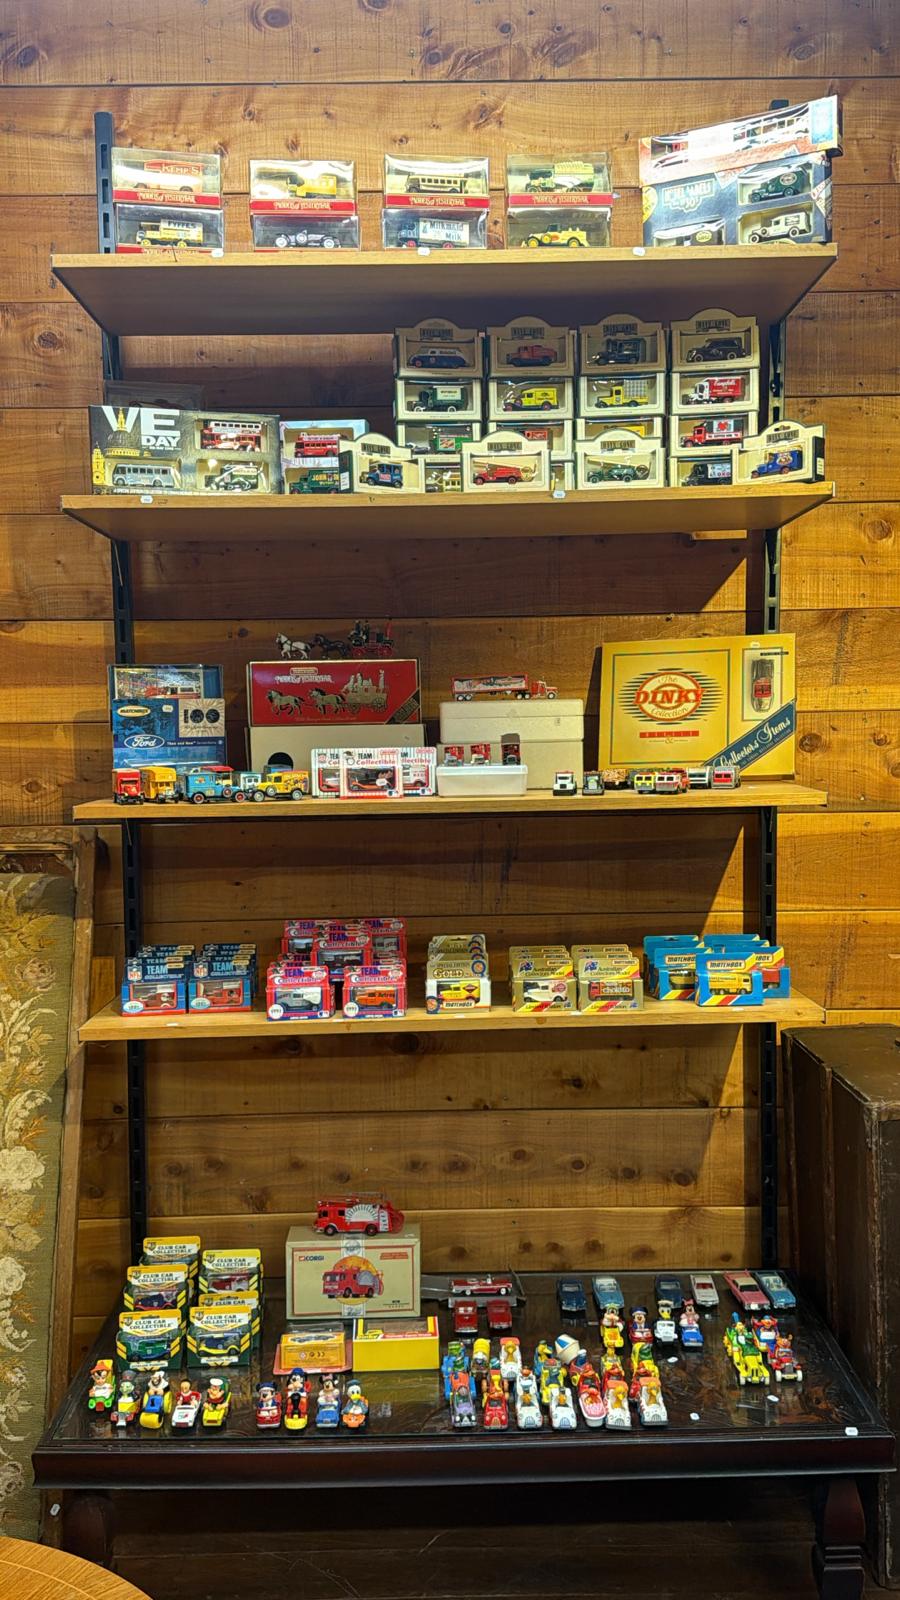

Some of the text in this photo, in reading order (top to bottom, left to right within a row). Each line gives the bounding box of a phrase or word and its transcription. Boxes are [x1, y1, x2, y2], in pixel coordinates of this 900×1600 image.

[141, 436, 181, 448] DAY
[633, 688, 705, 705] DINKY
[650, 705, 689, 718] Collection
[756, 717, 791, 744] Items
[131, 736, 157, 747] Ford
[328, 932, 348, 941] TEAM
[147, 965, 168, 975] TEAM
[212, 962, 234, 971] TEAM
[361, 967, 381, 975] TEAM
[284, 969, 304, 977] TEAM
